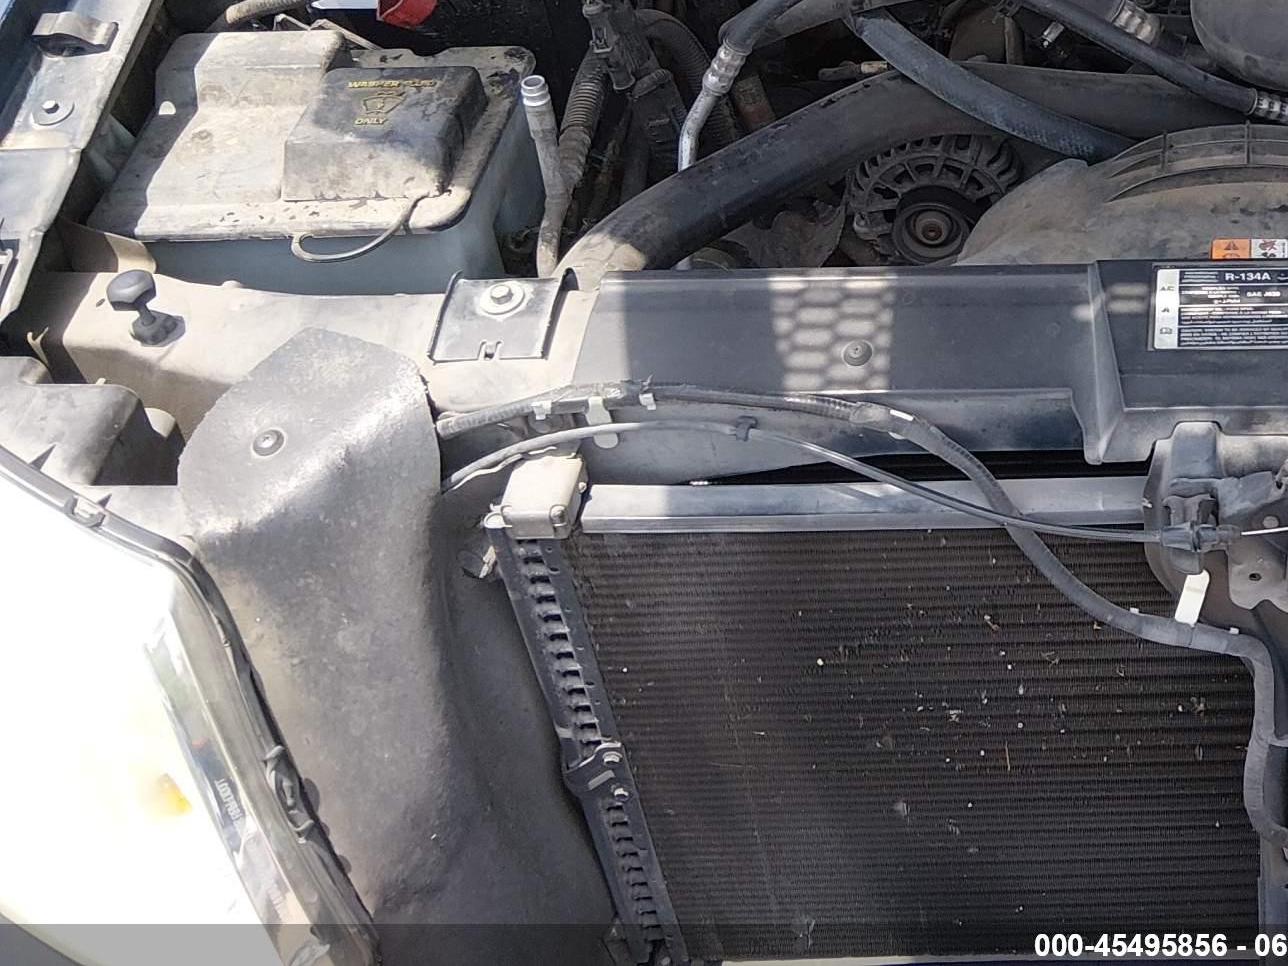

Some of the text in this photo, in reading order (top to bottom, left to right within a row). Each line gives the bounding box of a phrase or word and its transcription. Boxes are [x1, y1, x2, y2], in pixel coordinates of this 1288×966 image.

[348, 79, 401, 89] WASHER
[354, 116, 388, 126] ONLY
[1225, 272, 1271, 282] R-134A
